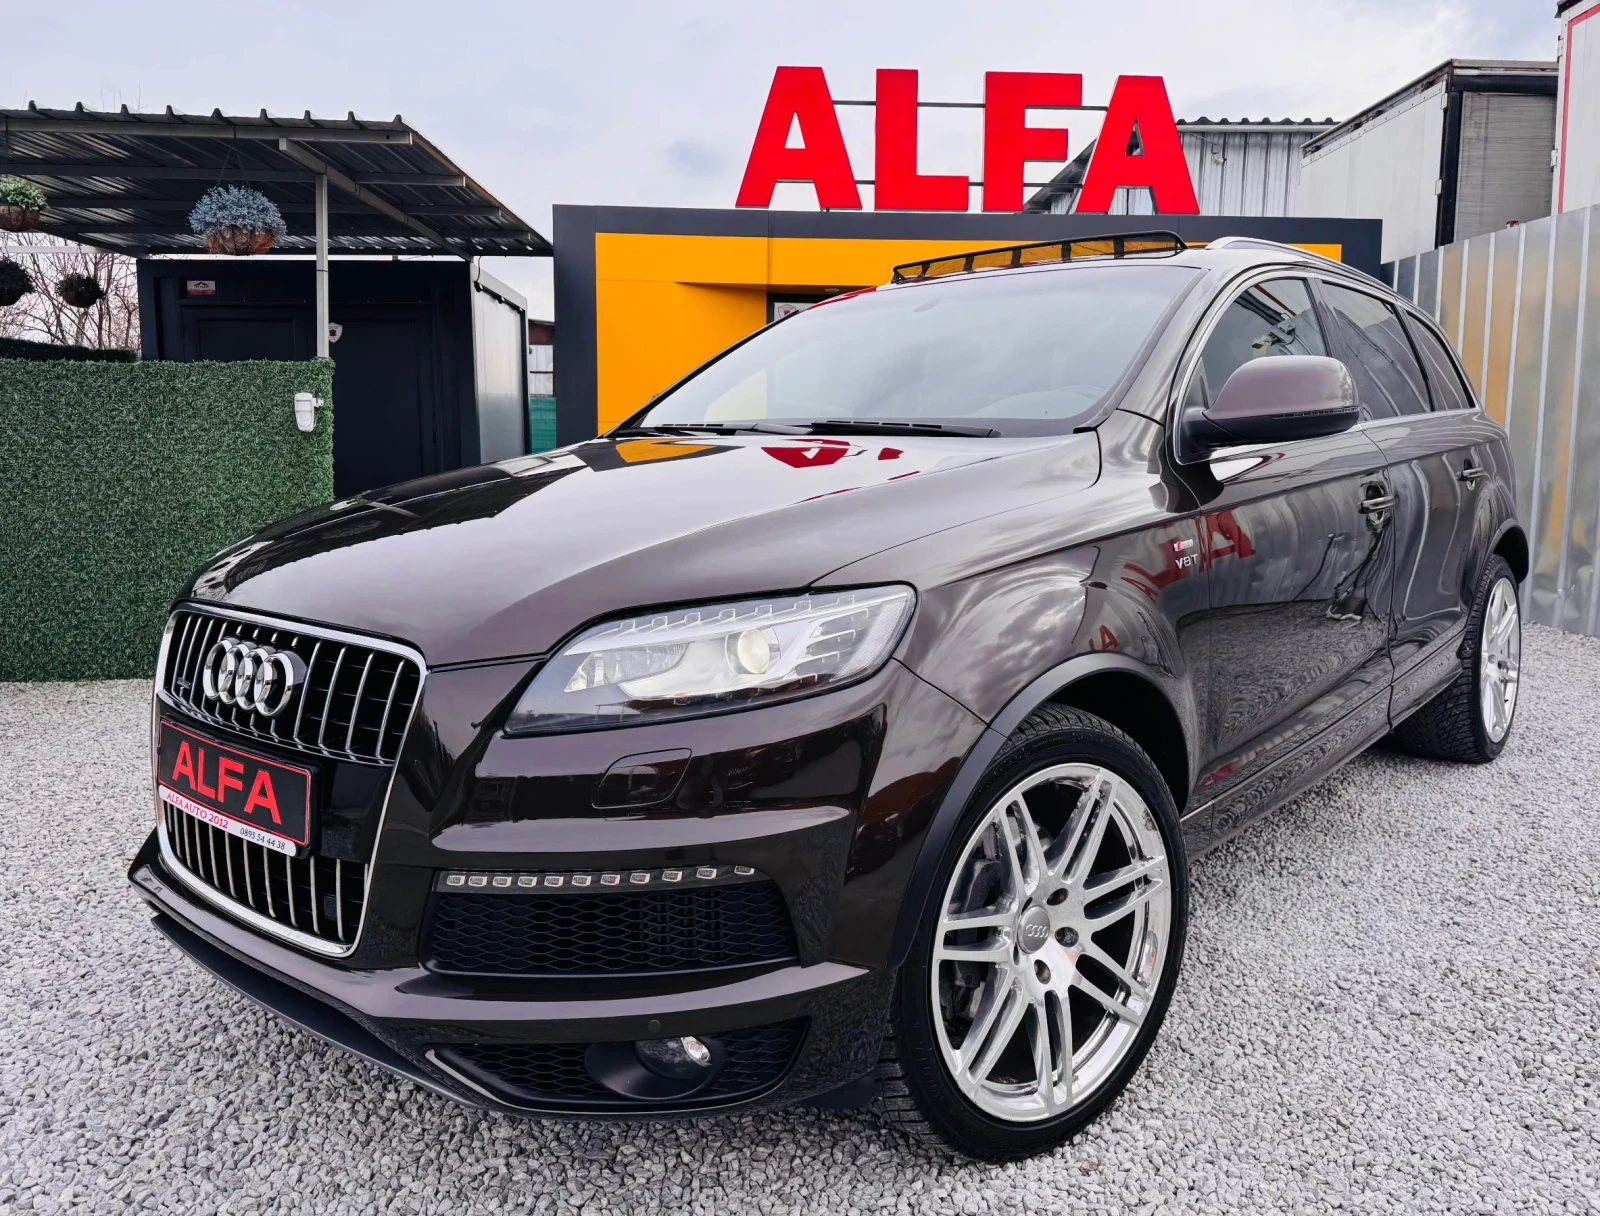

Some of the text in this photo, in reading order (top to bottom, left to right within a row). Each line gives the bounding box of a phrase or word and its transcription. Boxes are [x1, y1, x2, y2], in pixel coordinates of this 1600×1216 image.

[735, 66, 1200, 214] ALFA
[166, 793, 229, 829] ALFA AUTO 2012
[172, 741, 282, 825] ALFA
[240, 828, 286, 850] 0895 54 44 38
